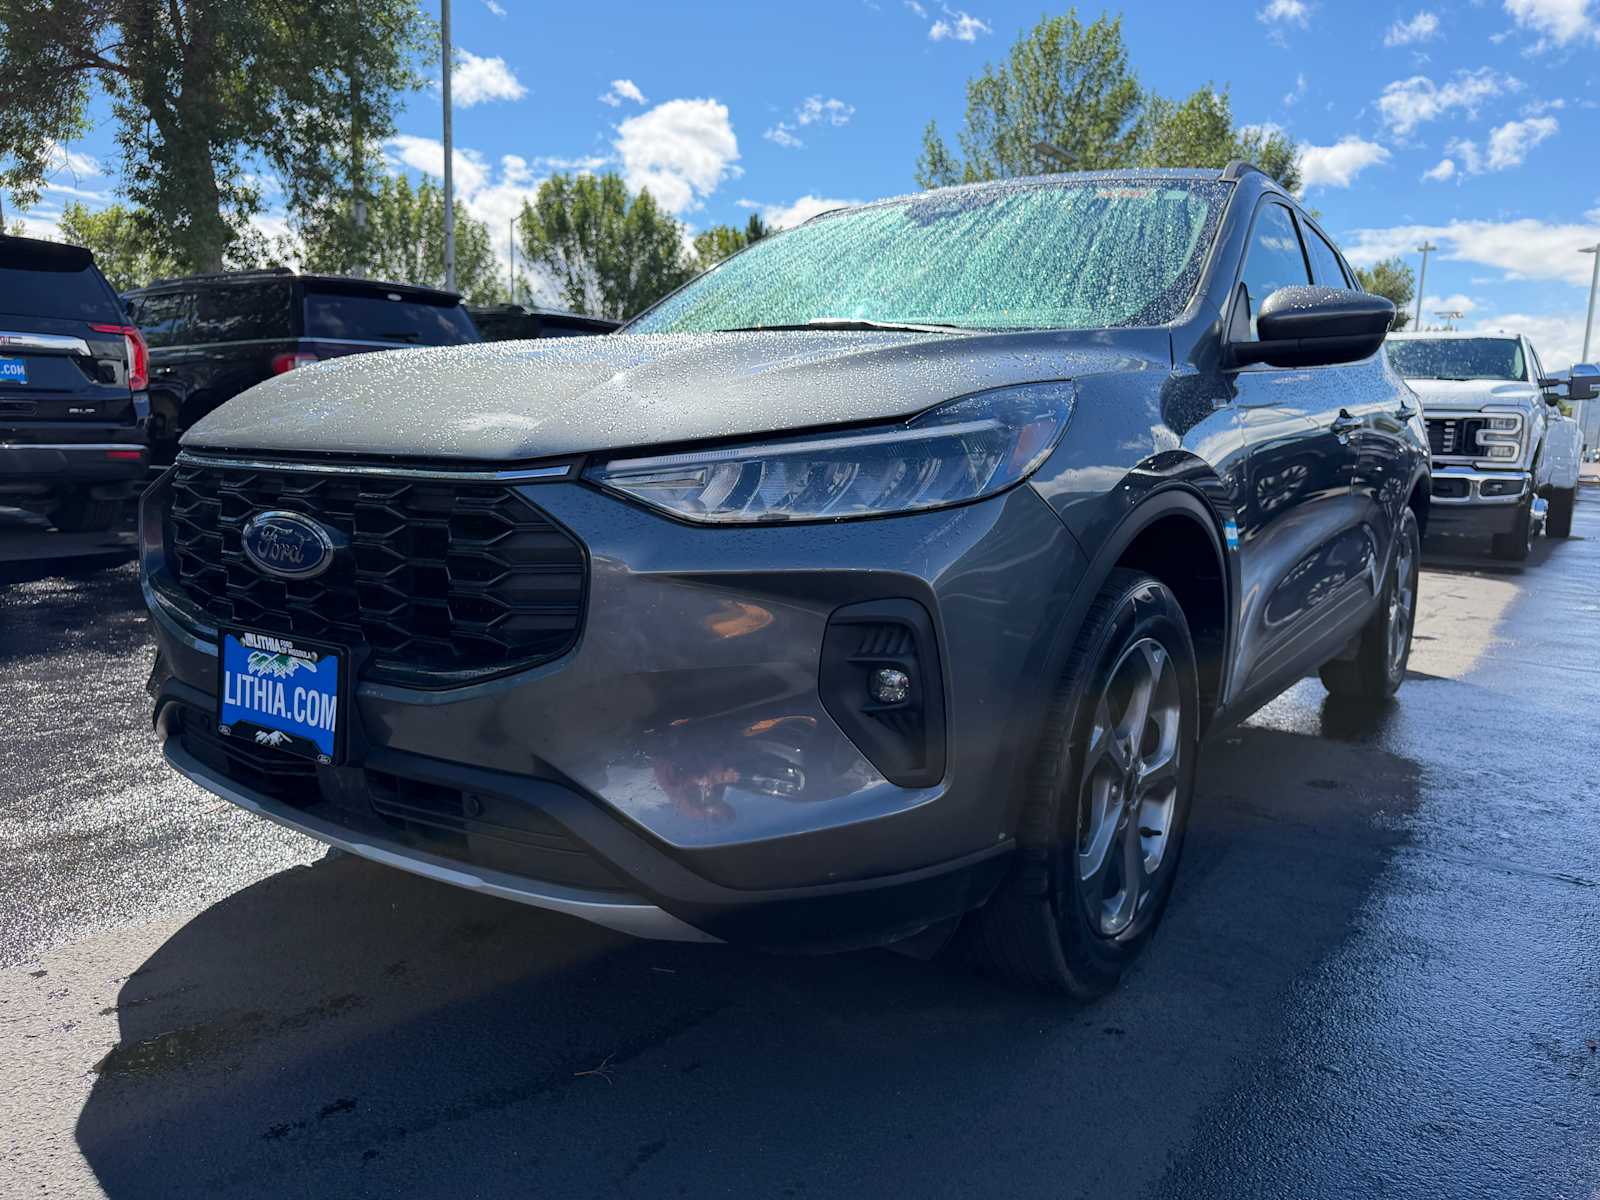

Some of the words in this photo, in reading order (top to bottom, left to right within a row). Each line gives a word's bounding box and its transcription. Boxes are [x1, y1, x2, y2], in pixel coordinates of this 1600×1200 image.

[257, 524, 305, 564] Ford
[252, 634, 281, 652] LITHIA
[224, 670, 338, 732] LITHIA.COM
